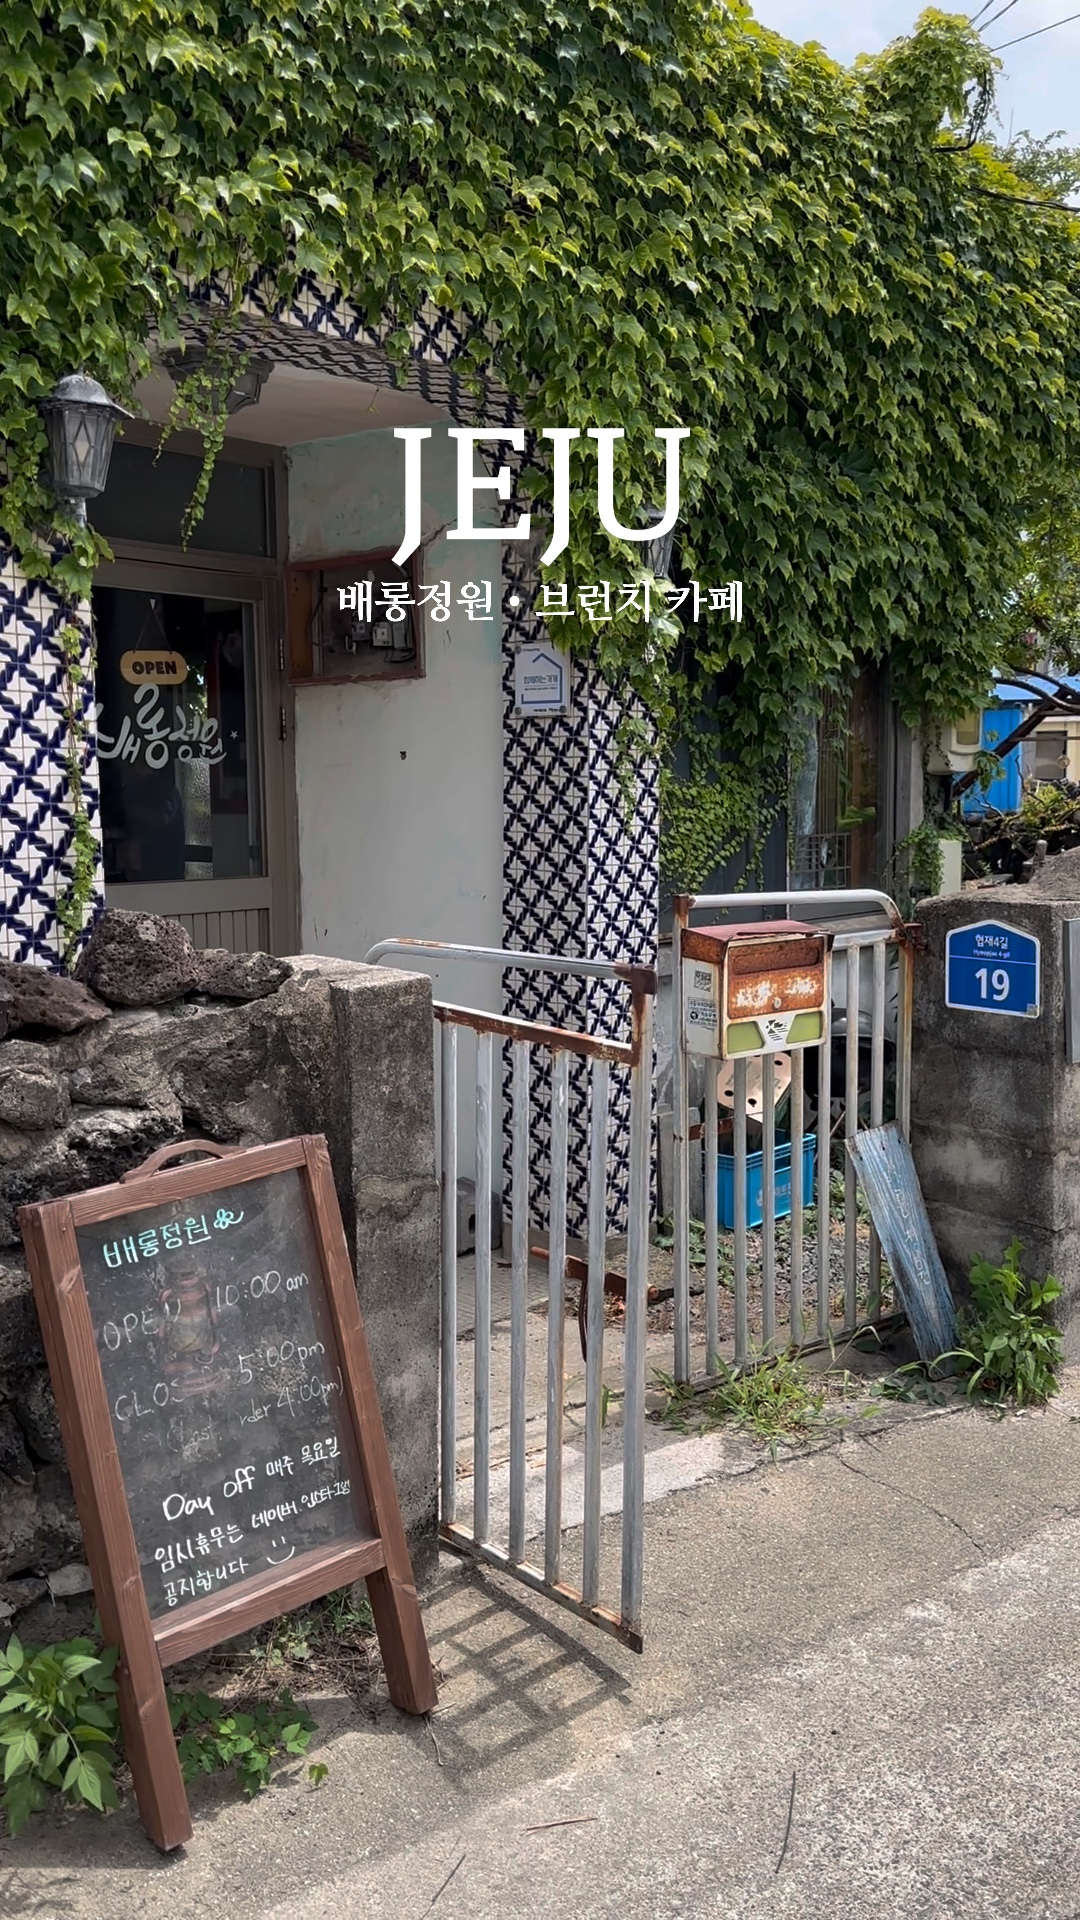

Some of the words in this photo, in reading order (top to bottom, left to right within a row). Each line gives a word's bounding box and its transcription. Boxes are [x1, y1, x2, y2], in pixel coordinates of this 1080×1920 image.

[132, 660, 177, 675] OPEN
[975, 933, 1009, 950] 협재4길
[975, 967, 1010, 1002] 19
[103, 1215, 212, 1268] 배롱정원
[215, 1270, 281, 1313] 10:00
[162, 1493, 214, 1521] Day
[223, 1466, 255, 1498] off
[266, 1456, 294, 1477] 매주
[301, 1437, 341, 1466] 목요일
[154, 1523, 244, 1573] 임시휴무는
[163, 1557, 249, 1607] 공지합니다
